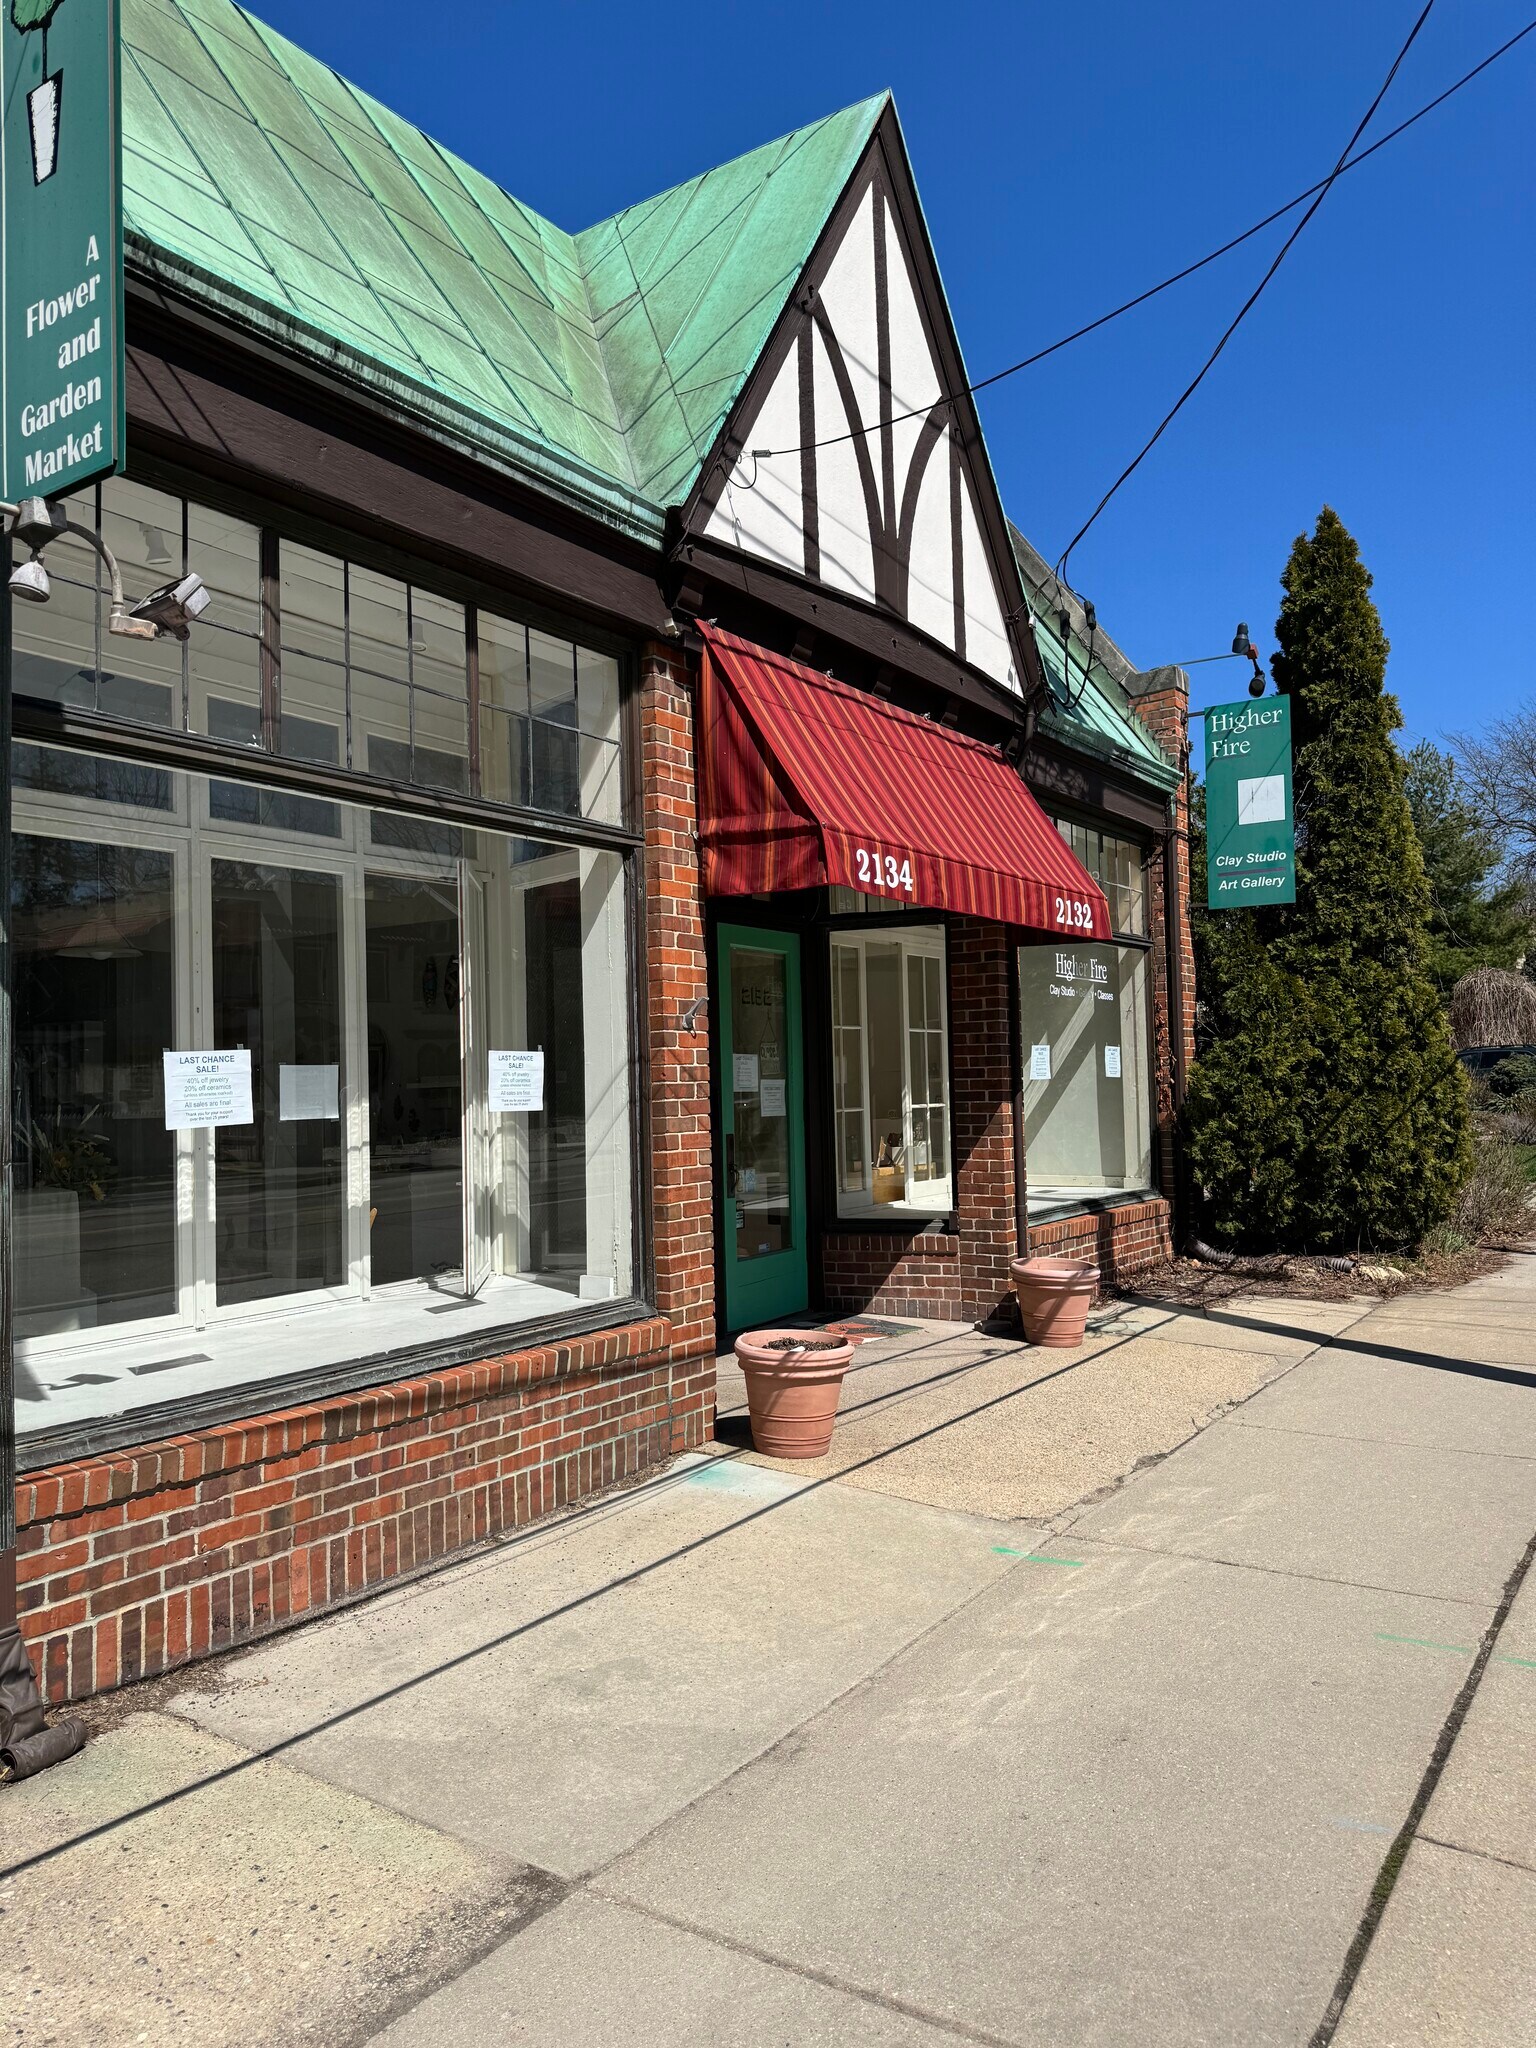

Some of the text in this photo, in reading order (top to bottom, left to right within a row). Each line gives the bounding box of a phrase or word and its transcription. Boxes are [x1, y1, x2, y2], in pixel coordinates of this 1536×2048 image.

[86, 234, 100, 267] A
[26, 273, 101, 339] Flower
[58, 316, 101, 370] and
[21, 375, 102, 438] Garden
[25, 421, 103, 487] Market
[1211, 707, 1283, 735] Higher
[1211, 739, 1251, 758] Fire
[856, 848, 914, 892] 2134
[1215, 850, 1287, 868] Clay Studio
[1218, 875, 1286, 891] Art Gallery
[1055, 897, 1094, 929] 2132
[1055, 953, 1108, 982] Higher Fire
[1049, 984, 1061, 998] Clay
[1061, 985, 1076, 997] Studio
[1097, 989, 1114, 1001] Classes
[179, 1055, 235, 1065] LAST CHANCE
[196, 1065, 219, 1073] SALE!
[209, 1076, 229, 1084] jewelry
